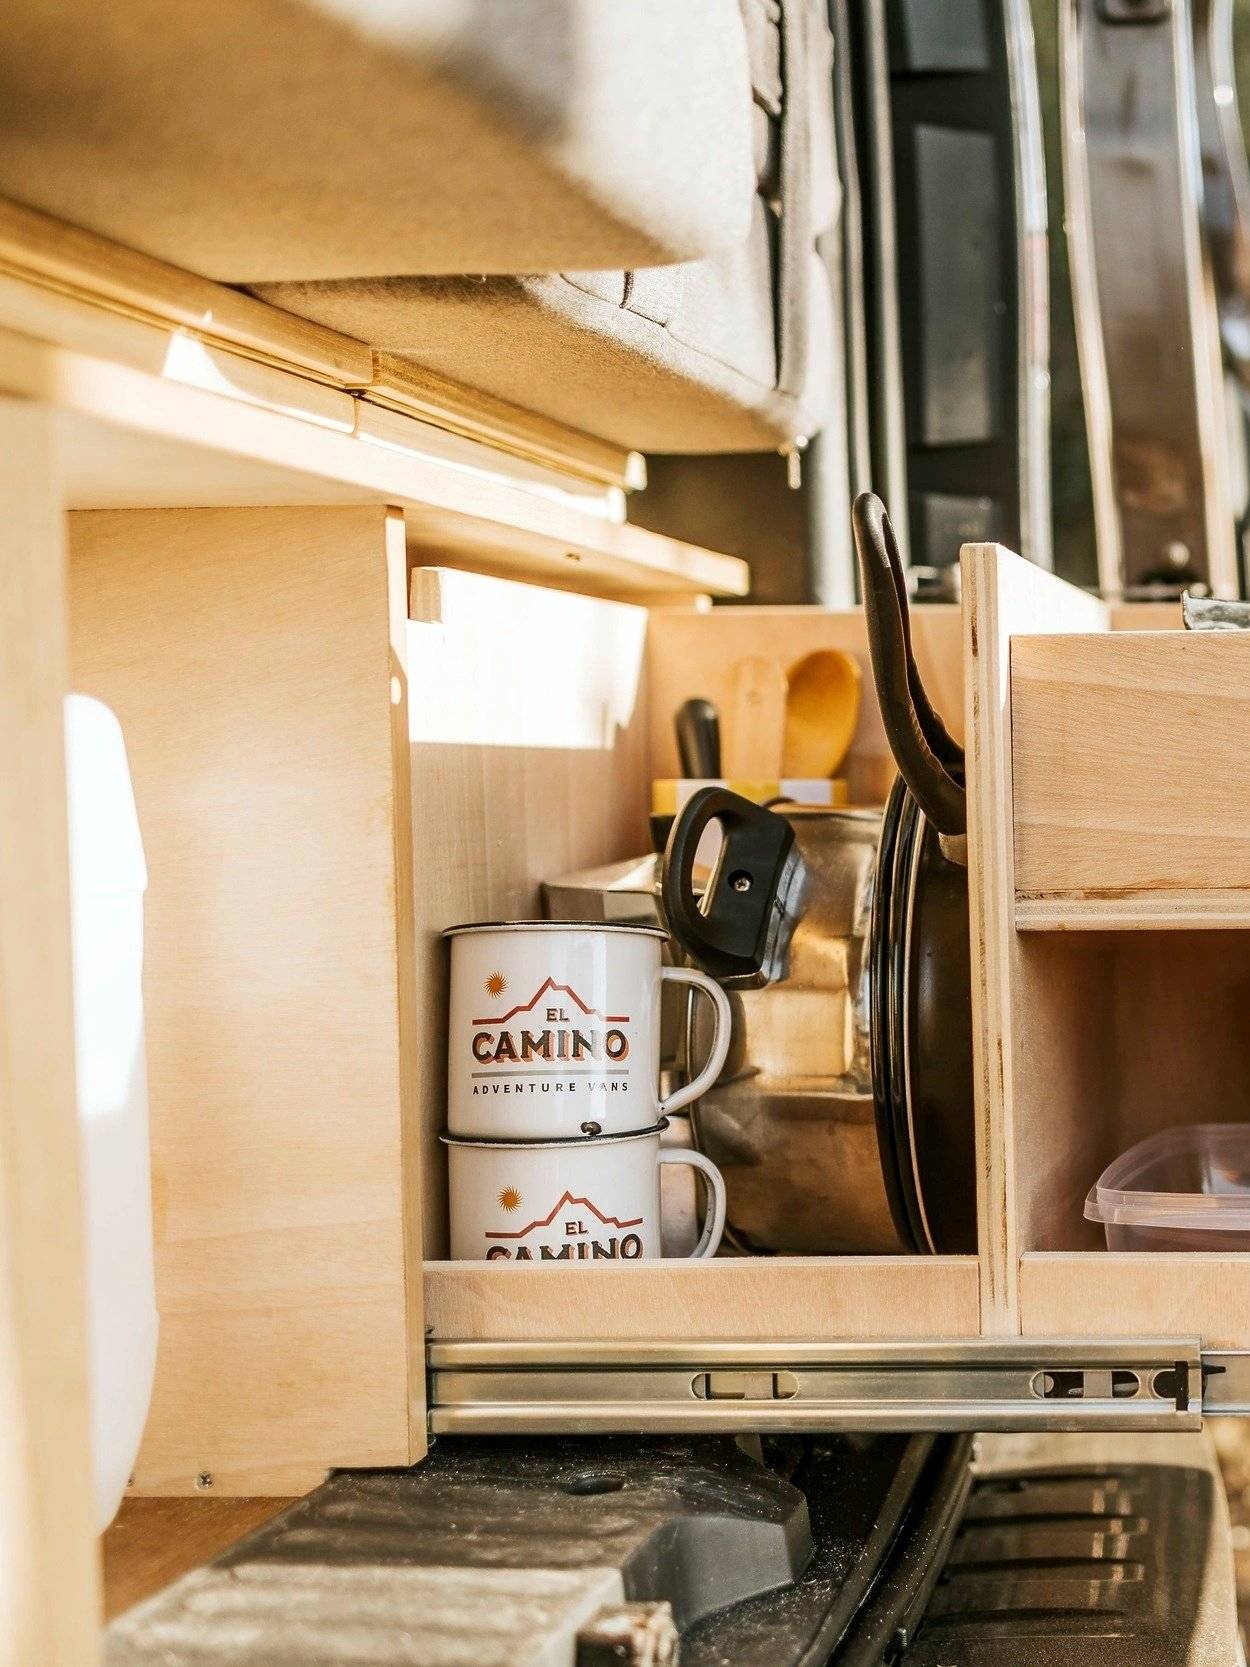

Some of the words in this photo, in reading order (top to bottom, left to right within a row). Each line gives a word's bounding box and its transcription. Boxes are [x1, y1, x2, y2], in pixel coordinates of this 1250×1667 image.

[546, 1008, 570, 1022] EL
[472, 1029, 630, 1064] CAMINO
[472, 1082, 577, 1095] ADVENTURE
[588, 1082, 629, 1092] VANS
[565, 1221, 590, 1235] EL
